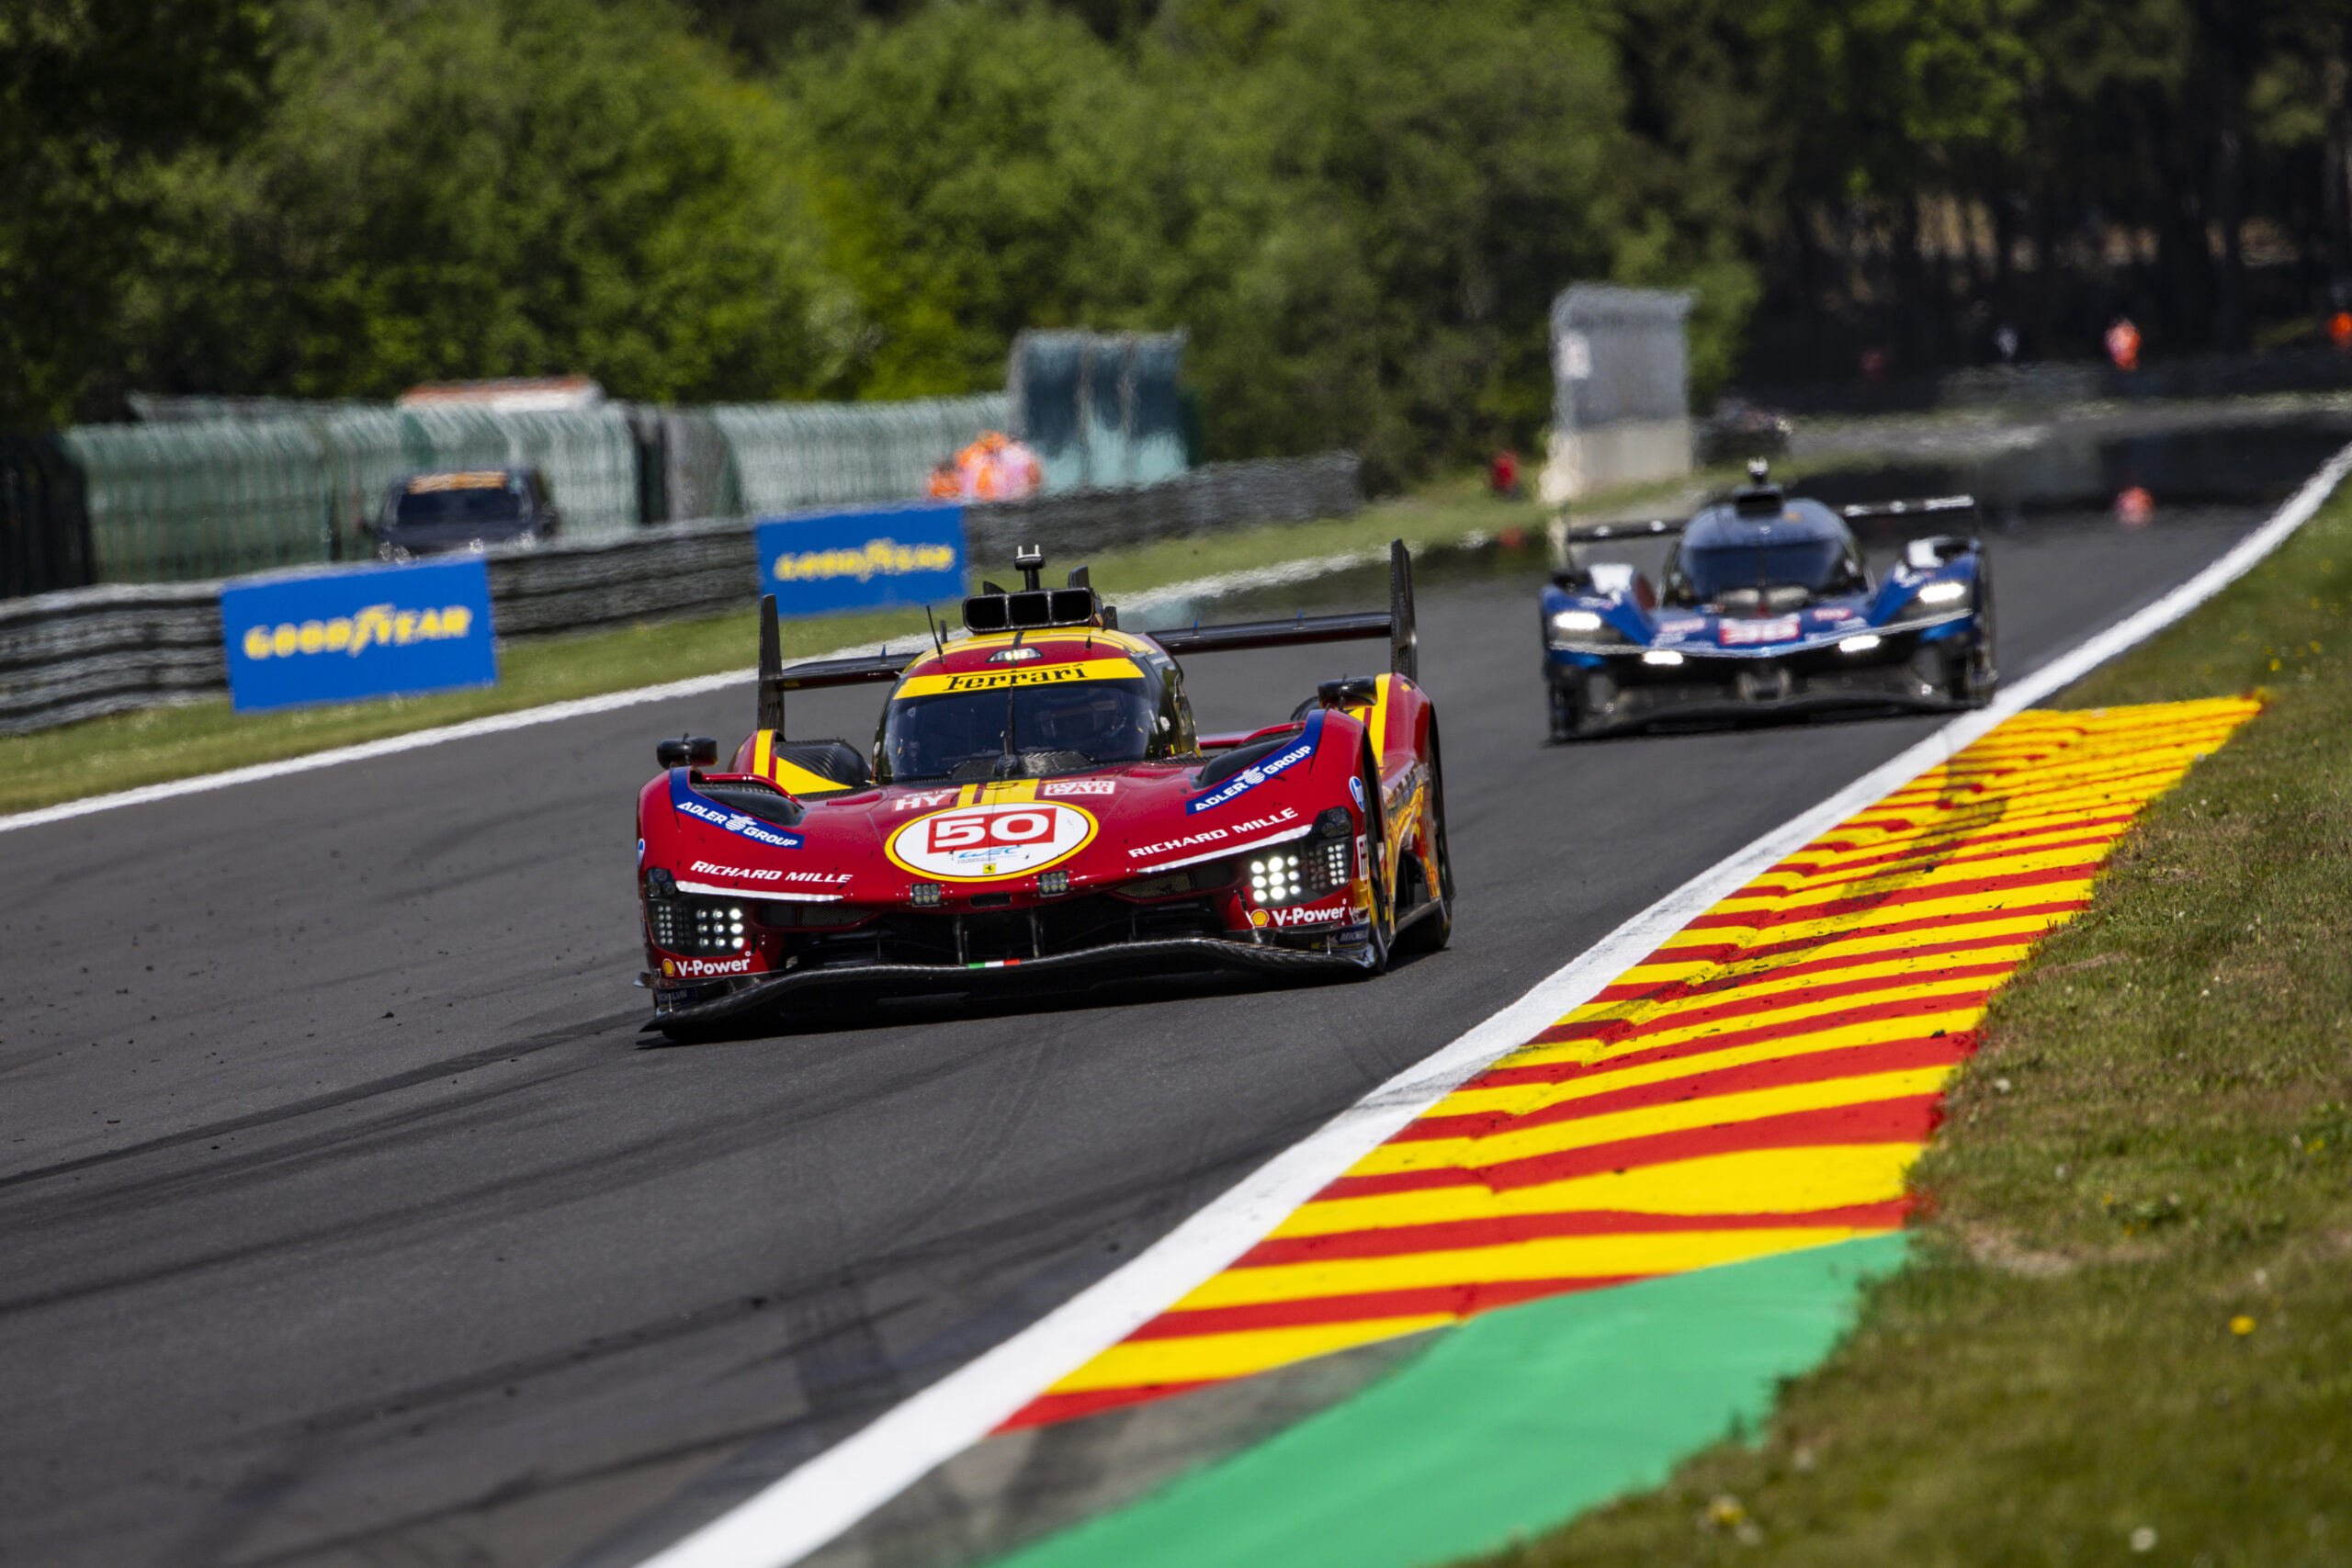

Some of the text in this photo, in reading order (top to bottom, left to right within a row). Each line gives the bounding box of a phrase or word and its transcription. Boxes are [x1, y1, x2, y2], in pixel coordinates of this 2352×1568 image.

[243, 604, 473, 660] GOODYEAR
[943, 663, 1088, 692] Ferrari
[1194, 745, 1312, 812] ADLER GROUP
[895, 795, 948, 811] HY
[676, 801, 798, 847] ADLER GROUP
[934, 813, 1049, 848] 50
[1127, 807, 1298, 858] RICHARD MILLE
[690, 860, 853, 884] RICHARD MILLE
[1272, 906, 1346, 927] V-Power
[676, 958, 751, 976] V-Power
